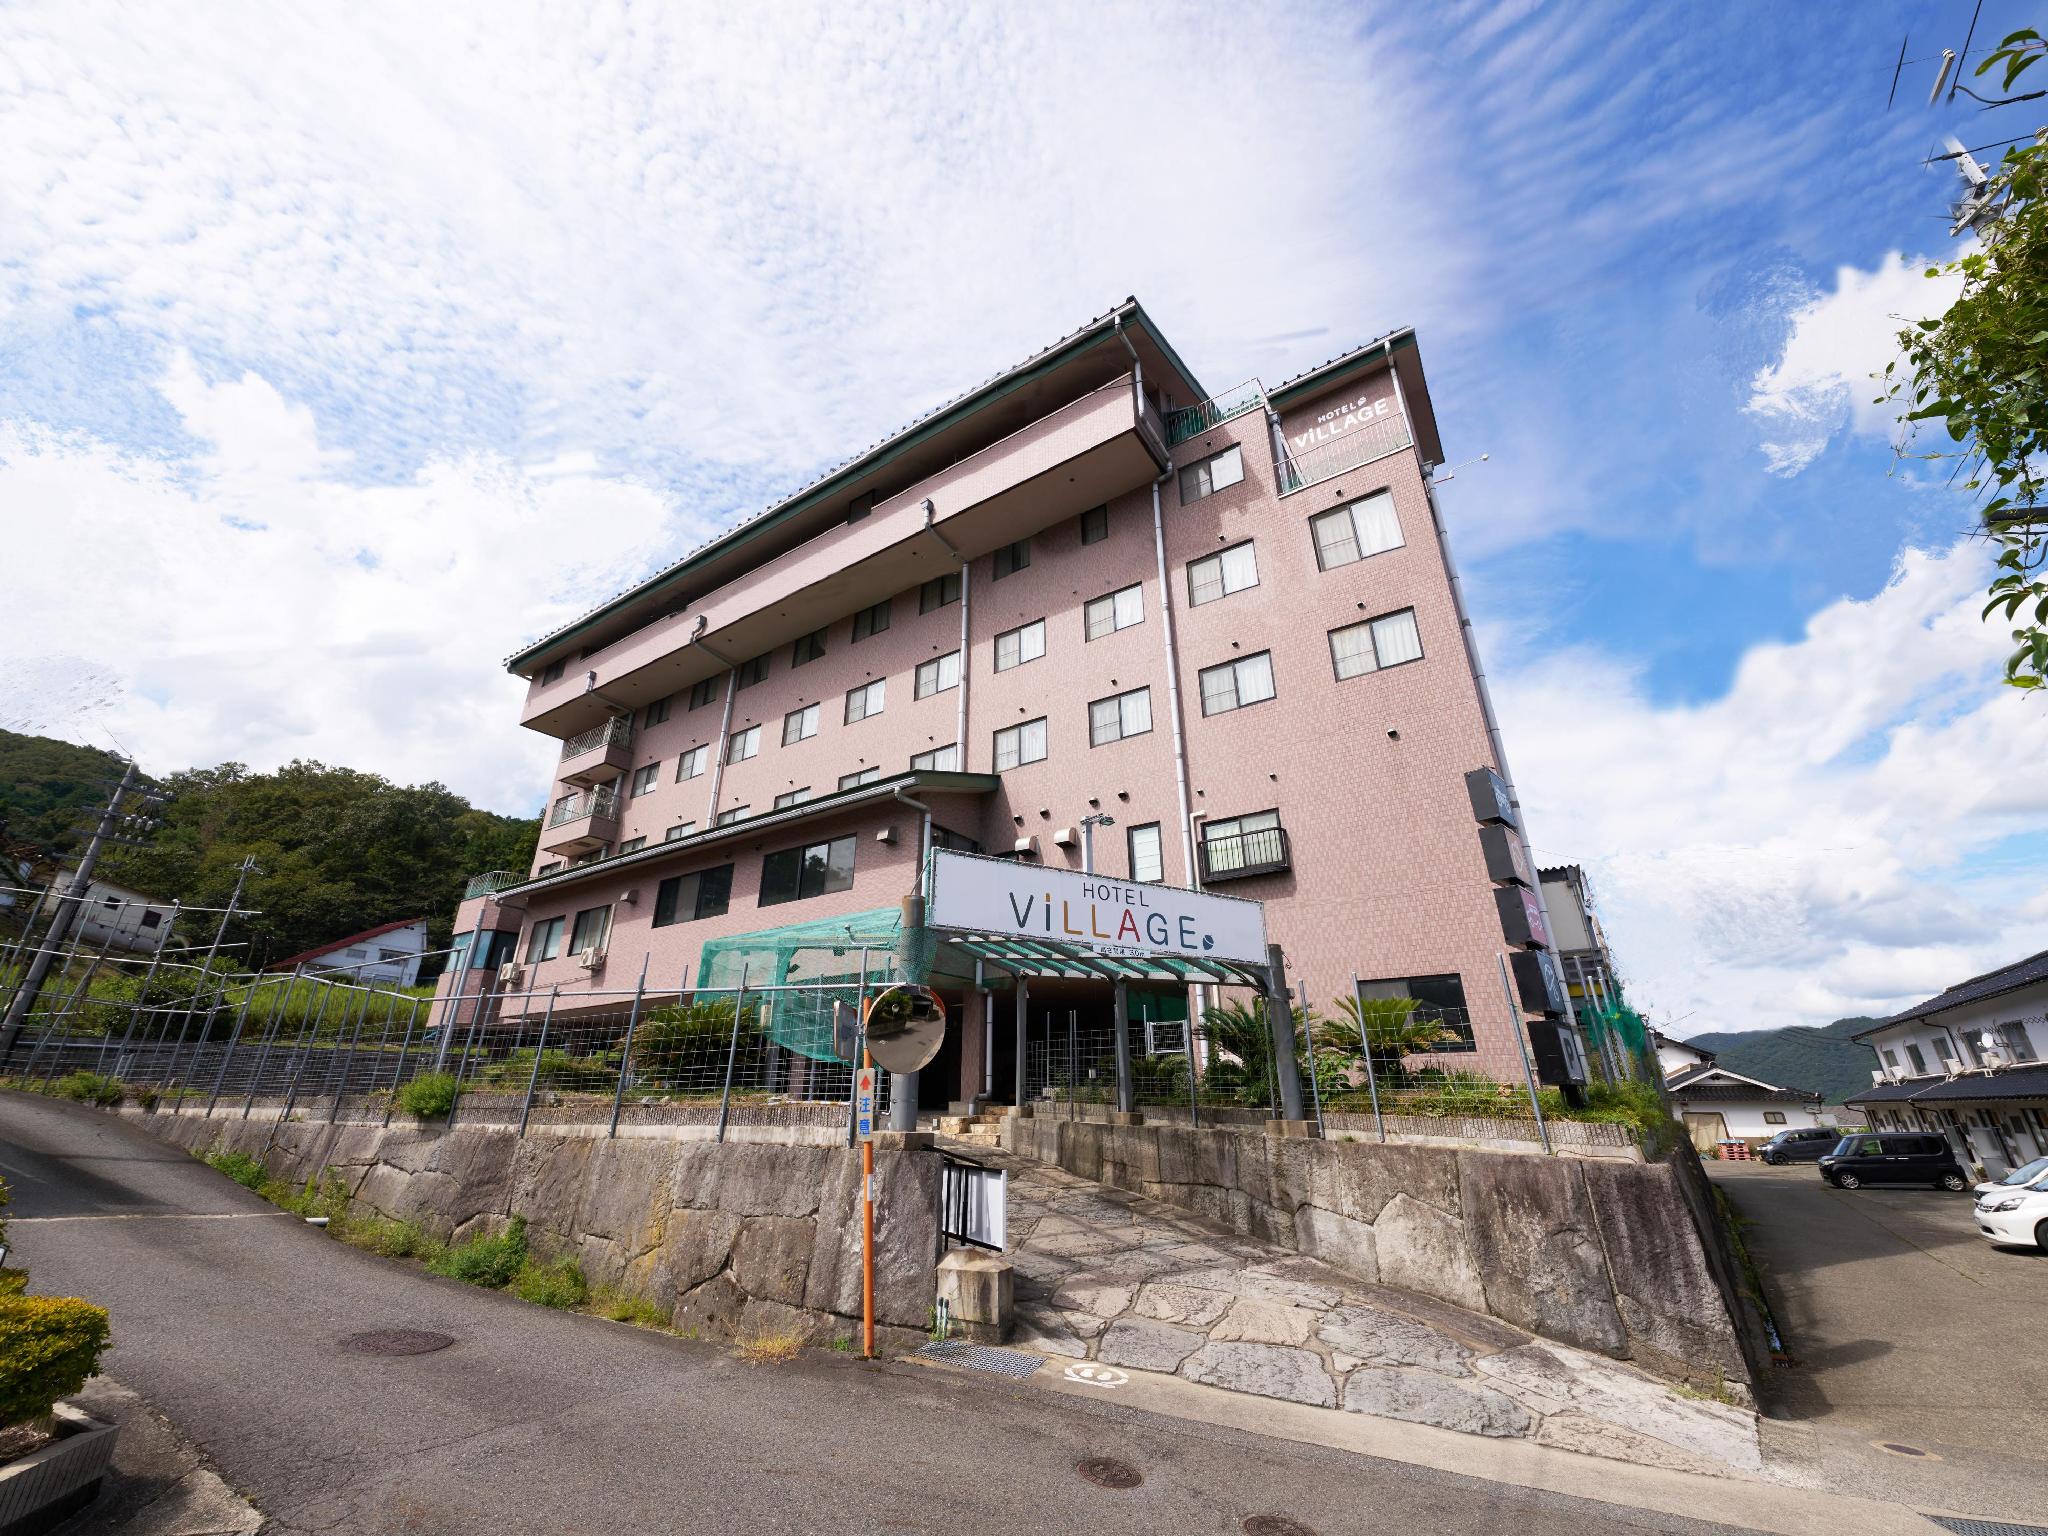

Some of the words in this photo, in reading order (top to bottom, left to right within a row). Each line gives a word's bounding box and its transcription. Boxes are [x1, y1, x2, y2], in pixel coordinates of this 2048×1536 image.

[1317, 402, 1357, 423] HOTEL
[1083, 882, 1149, 907] HOTEL
[1563, 1037, 1575, 1070] P
[859, 1097, 871, 1135] 注意
